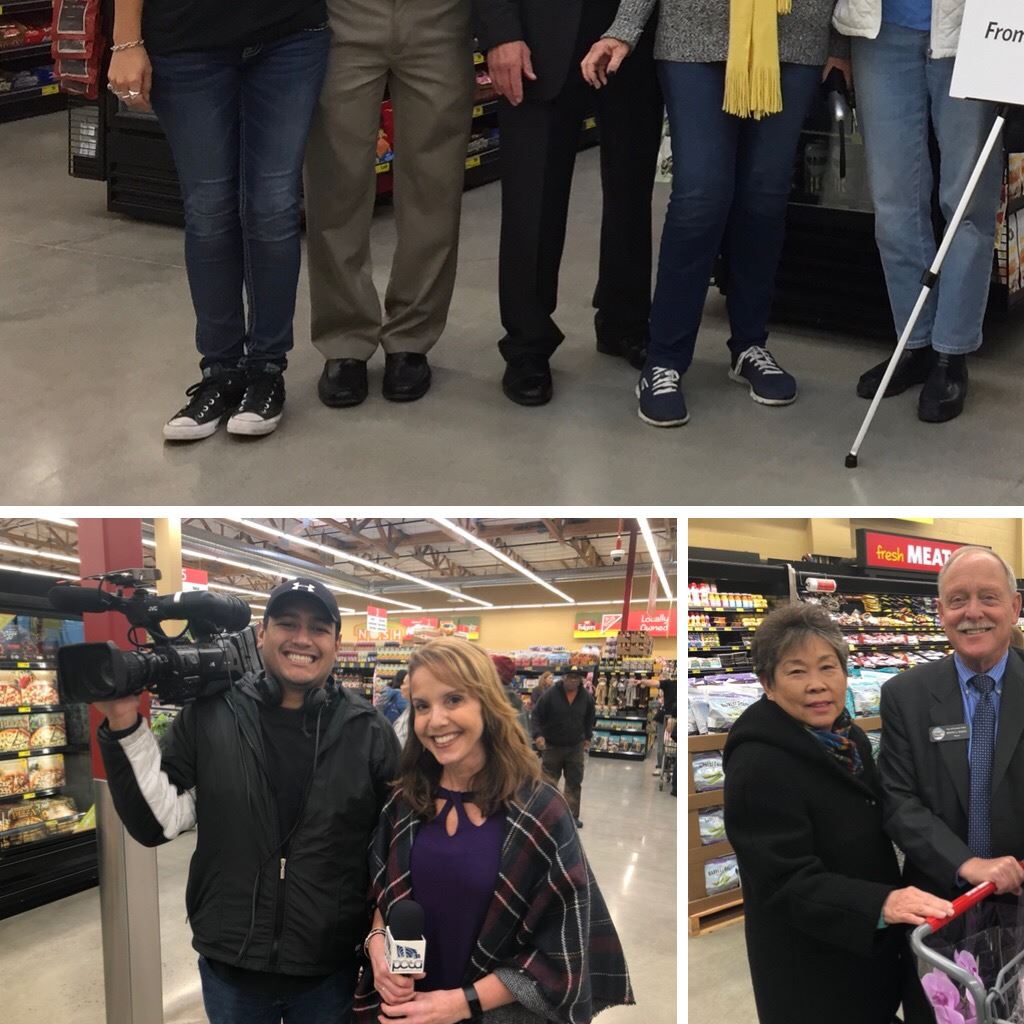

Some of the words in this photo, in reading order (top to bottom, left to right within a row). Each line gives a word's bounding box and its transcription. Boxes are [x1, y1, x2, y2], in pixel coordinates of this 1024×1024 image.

[876, 544, 904, 562] fresh
[641, 613, 670, 624] Locally
[640, 623, 668, 631] Owned
